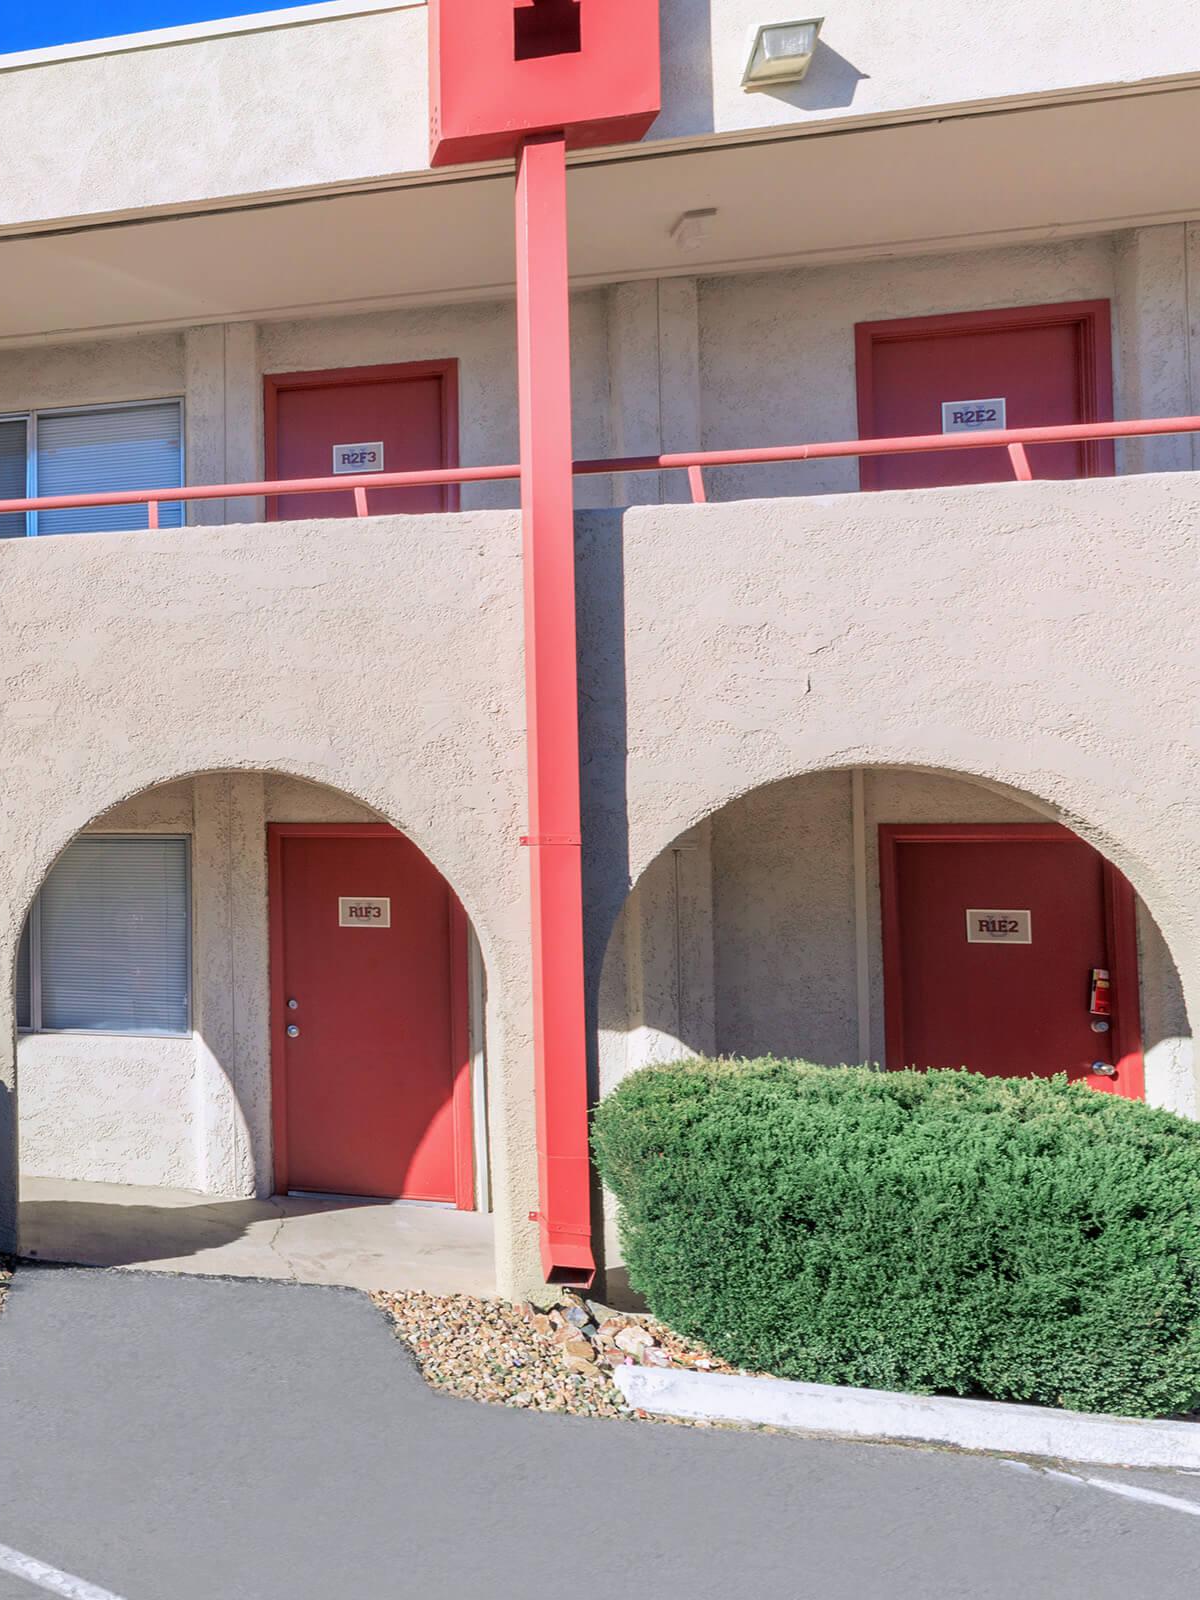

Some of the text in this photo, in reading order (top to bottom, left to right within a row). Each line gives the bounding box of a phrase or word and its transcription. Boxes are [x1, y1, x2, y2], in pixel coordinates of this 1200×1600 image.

[953, 409, 996, 424] R2E2
[341, 451, 377, 464] R2F3
[349, 906, 381, 918] R1F3
[978, 919, 1019, 933] R1E2
